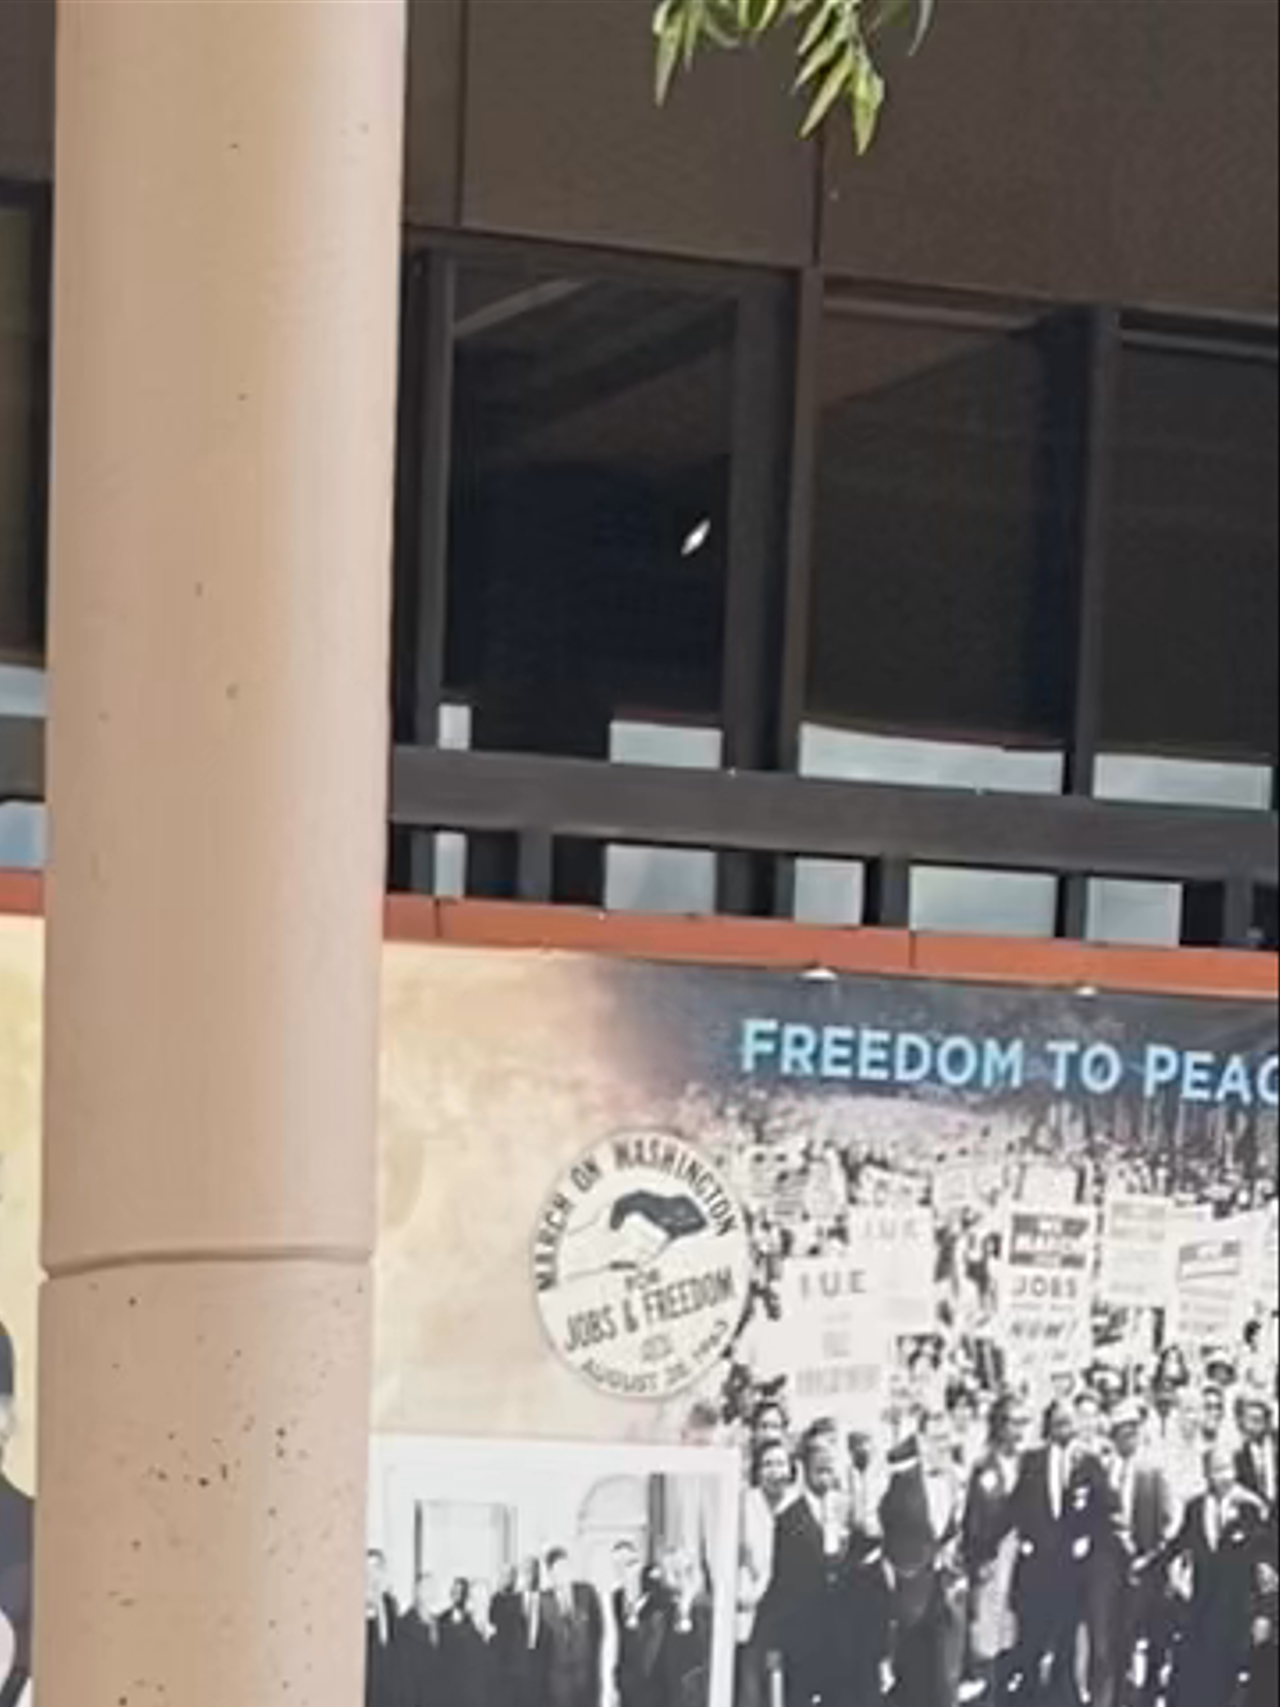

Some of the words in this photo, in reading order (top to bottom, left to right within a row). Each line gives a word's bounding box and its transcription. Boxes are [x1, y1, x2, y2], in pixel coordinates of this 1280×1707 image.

[740, 1018, 1025, 1088] FREEDOM
[1045, 1041, 1121, 1093] TO
[612, 1139, 738, 1237] WASHINGTON
[566, 1304, 618, 1351] JOBS
[643, 1264, 734, 1325] FREEDOM
